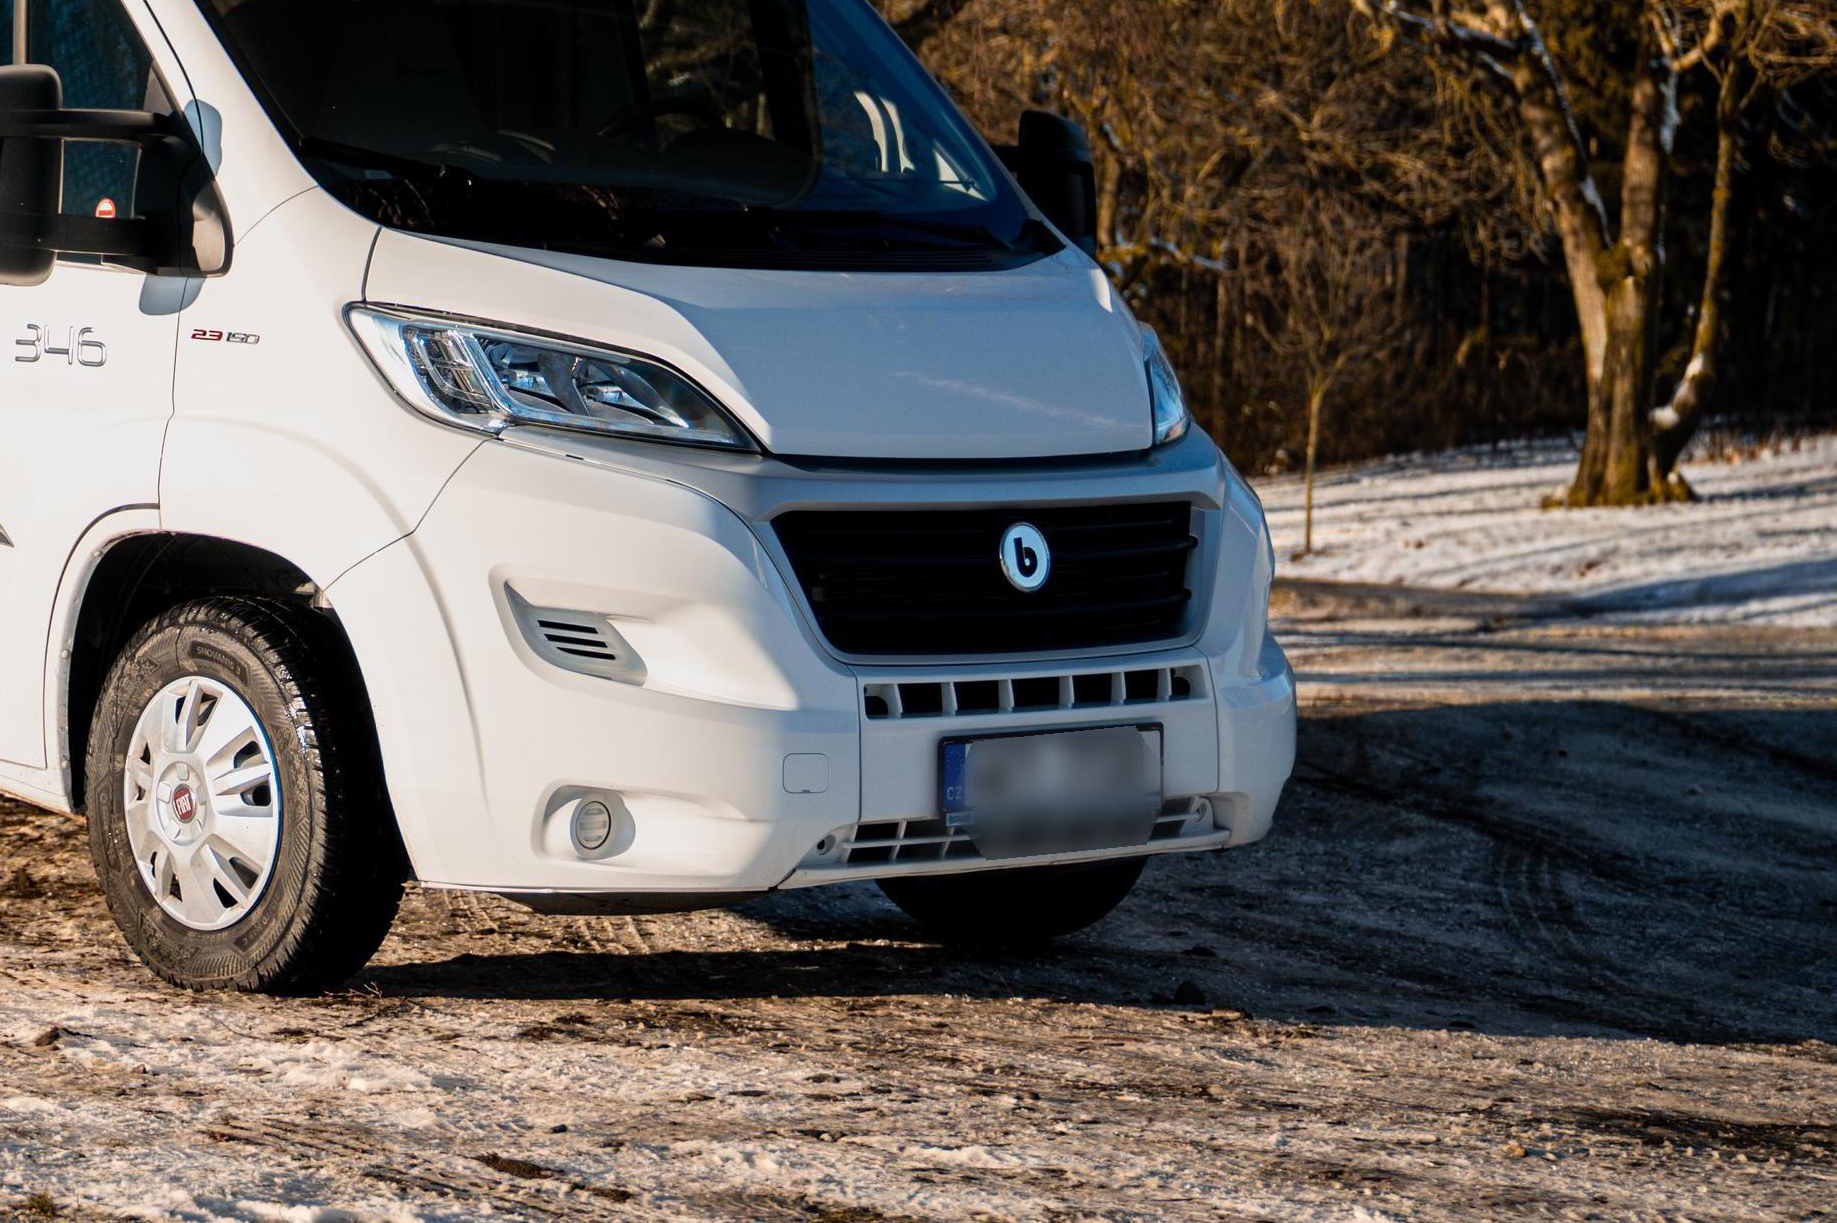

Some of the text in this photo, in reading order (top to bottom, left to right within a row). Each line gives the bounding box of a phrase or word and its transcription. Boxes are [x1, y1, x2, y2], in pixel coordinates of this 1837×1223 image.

[14, 323, 108, 368] 346
[226, 331, 261, 346] 150
[946, 784, 963, 801] CZ
[175, 793, 192, 816] FIAT
